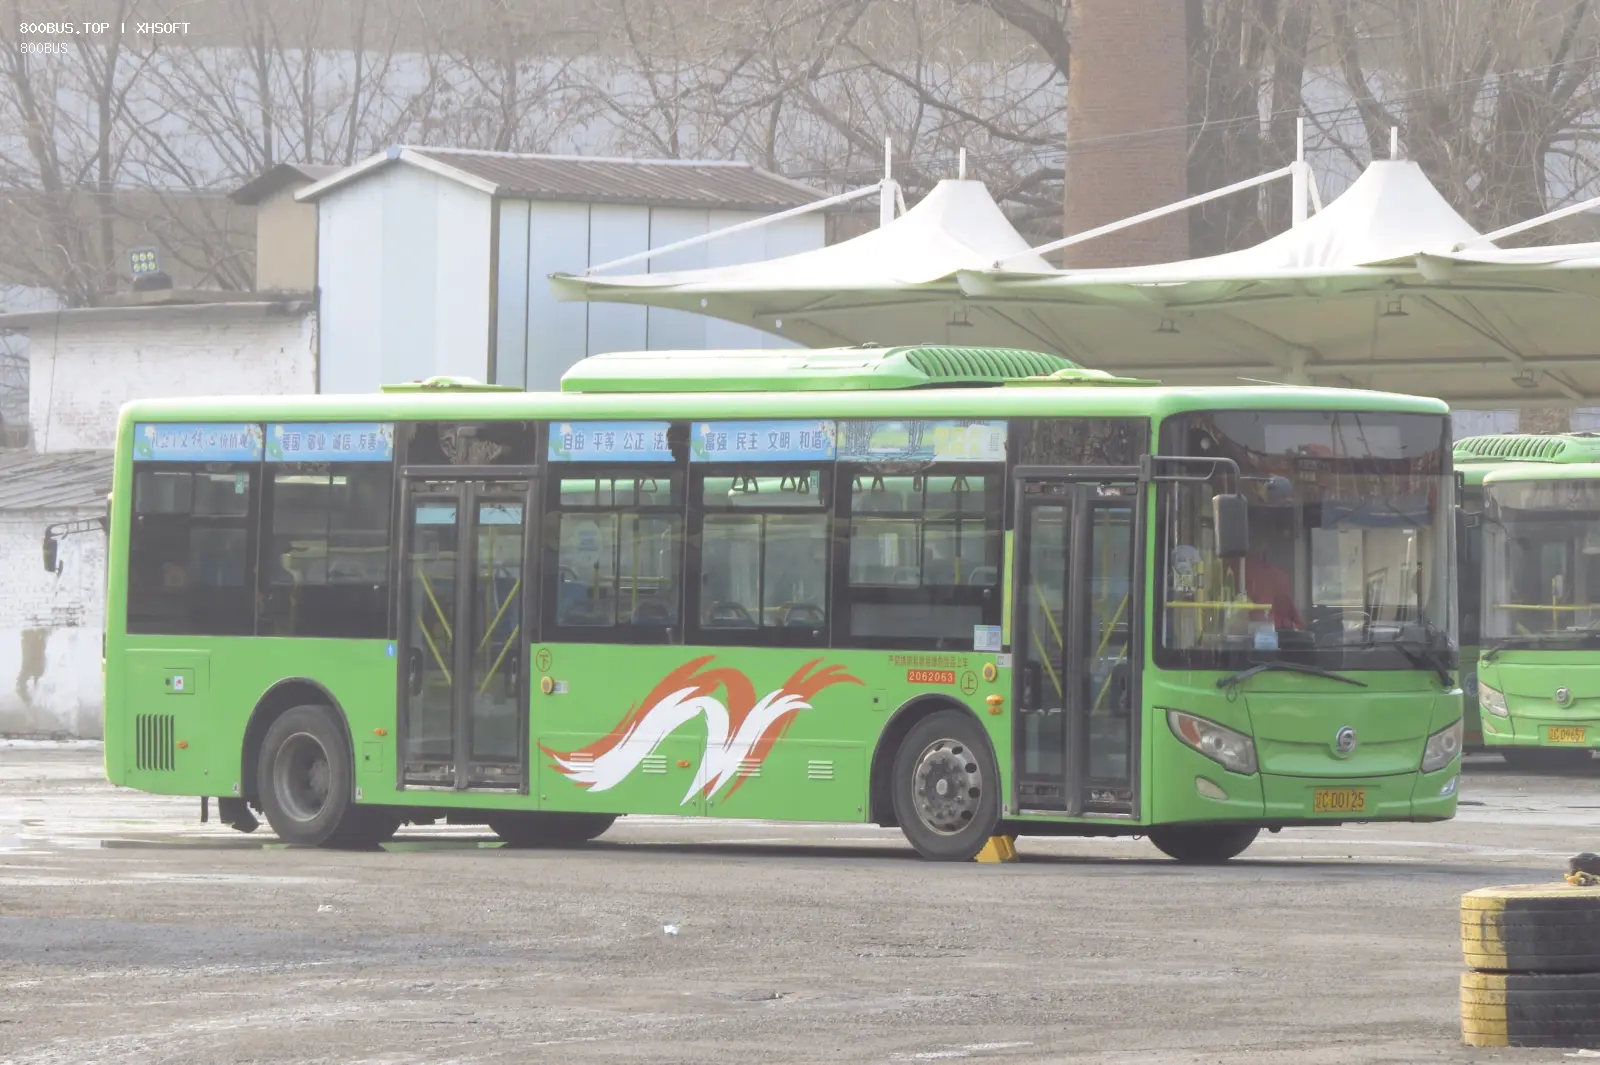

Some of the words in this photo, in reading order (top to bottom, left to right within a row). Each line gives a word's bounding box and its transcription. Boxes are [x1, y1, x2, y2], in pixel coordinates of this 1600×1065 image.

[282, 433, 301, 451] 爱国
[563, 432, 584, 450] 自由
[593, 432, 615, 451] 平等
[624, 432, 645, 450] 公正
[705, 432, 728, 451] 富强
[736, 431, 758, 450] 民主
[768, 431, 790, 450] 文明
[799, 430, 822, 449] 和谐
[908, 671, 953, 683] 2062063
